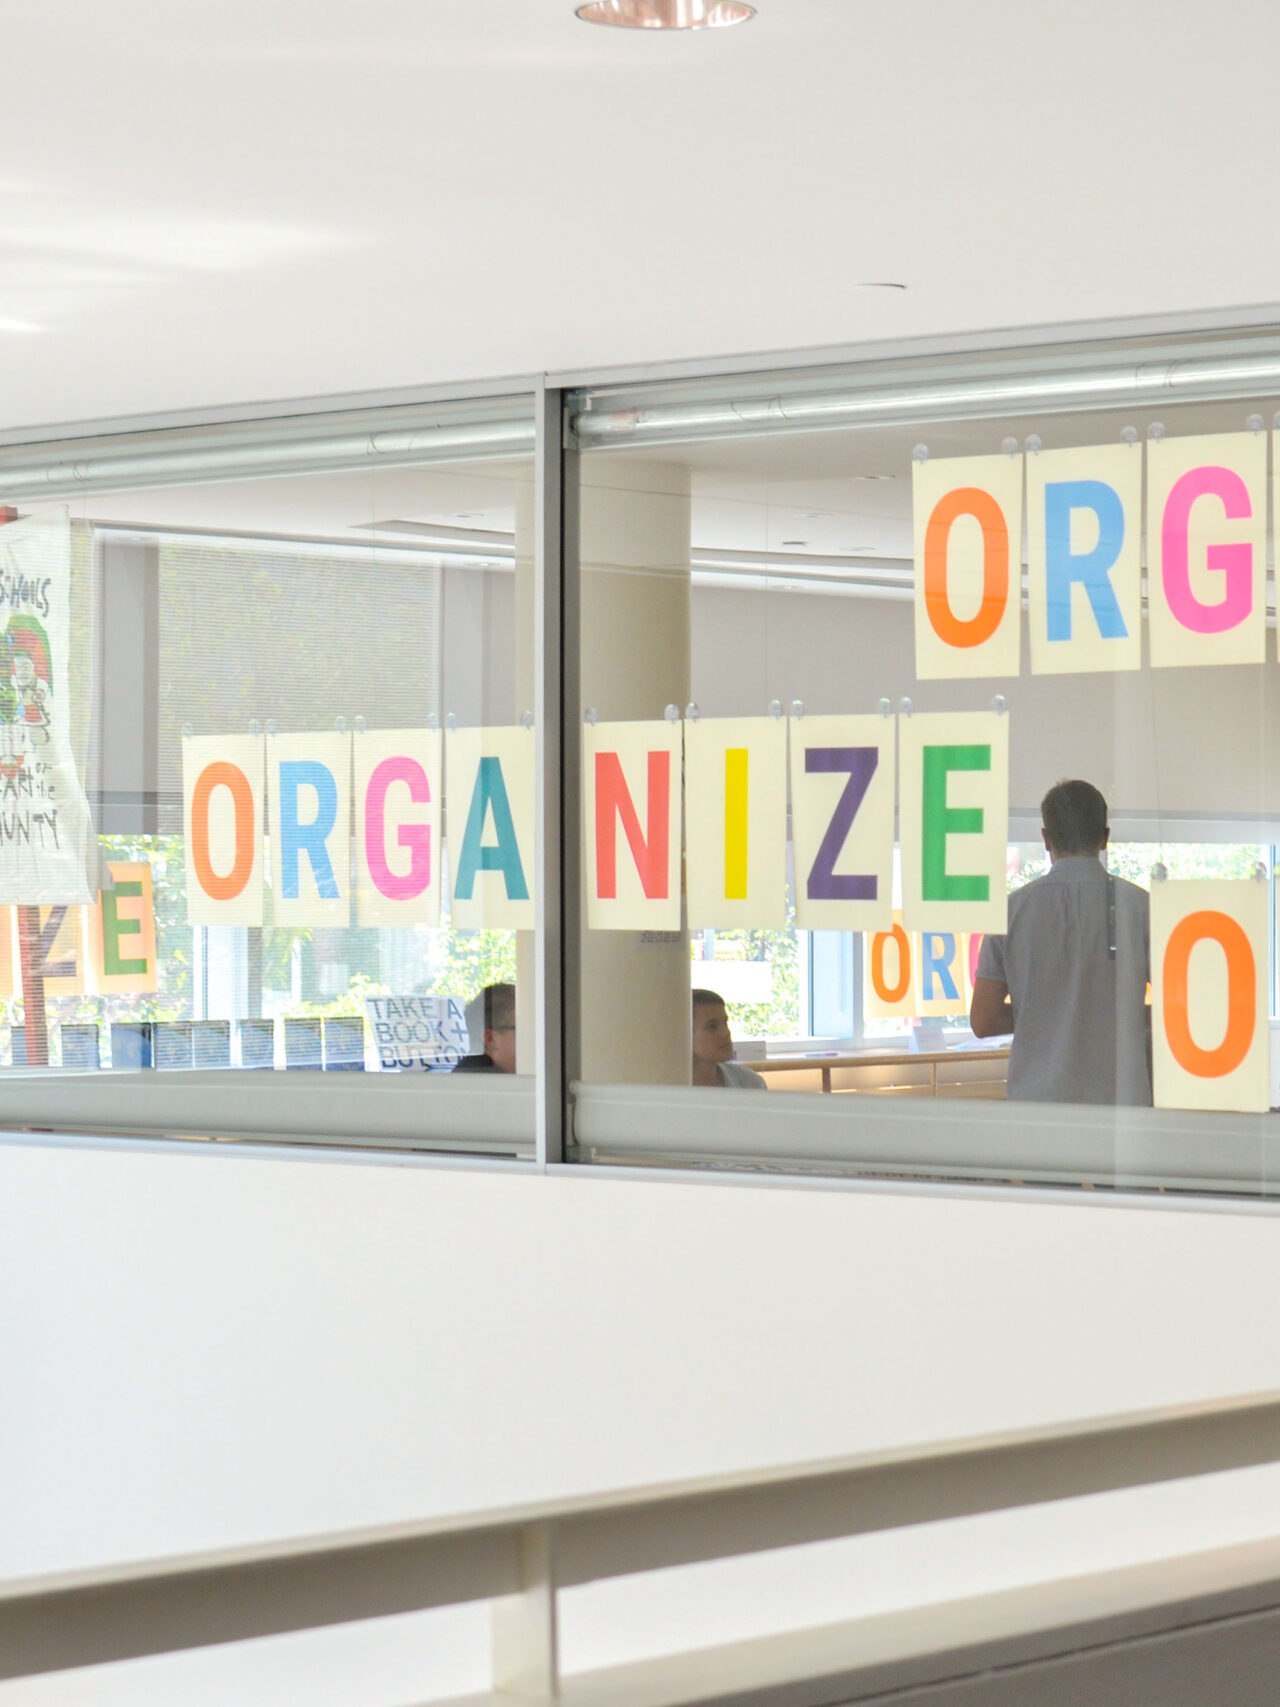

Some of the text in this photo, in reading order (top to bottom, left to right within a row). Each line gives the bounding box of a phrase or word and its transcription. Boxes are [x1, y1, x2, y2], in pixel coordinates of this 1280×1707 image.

[191, 744, 991, 901] ORGANIZE
[366, 997, 463, 1020] TAKE A
[375, 1020, 448, 1044] BOOK
